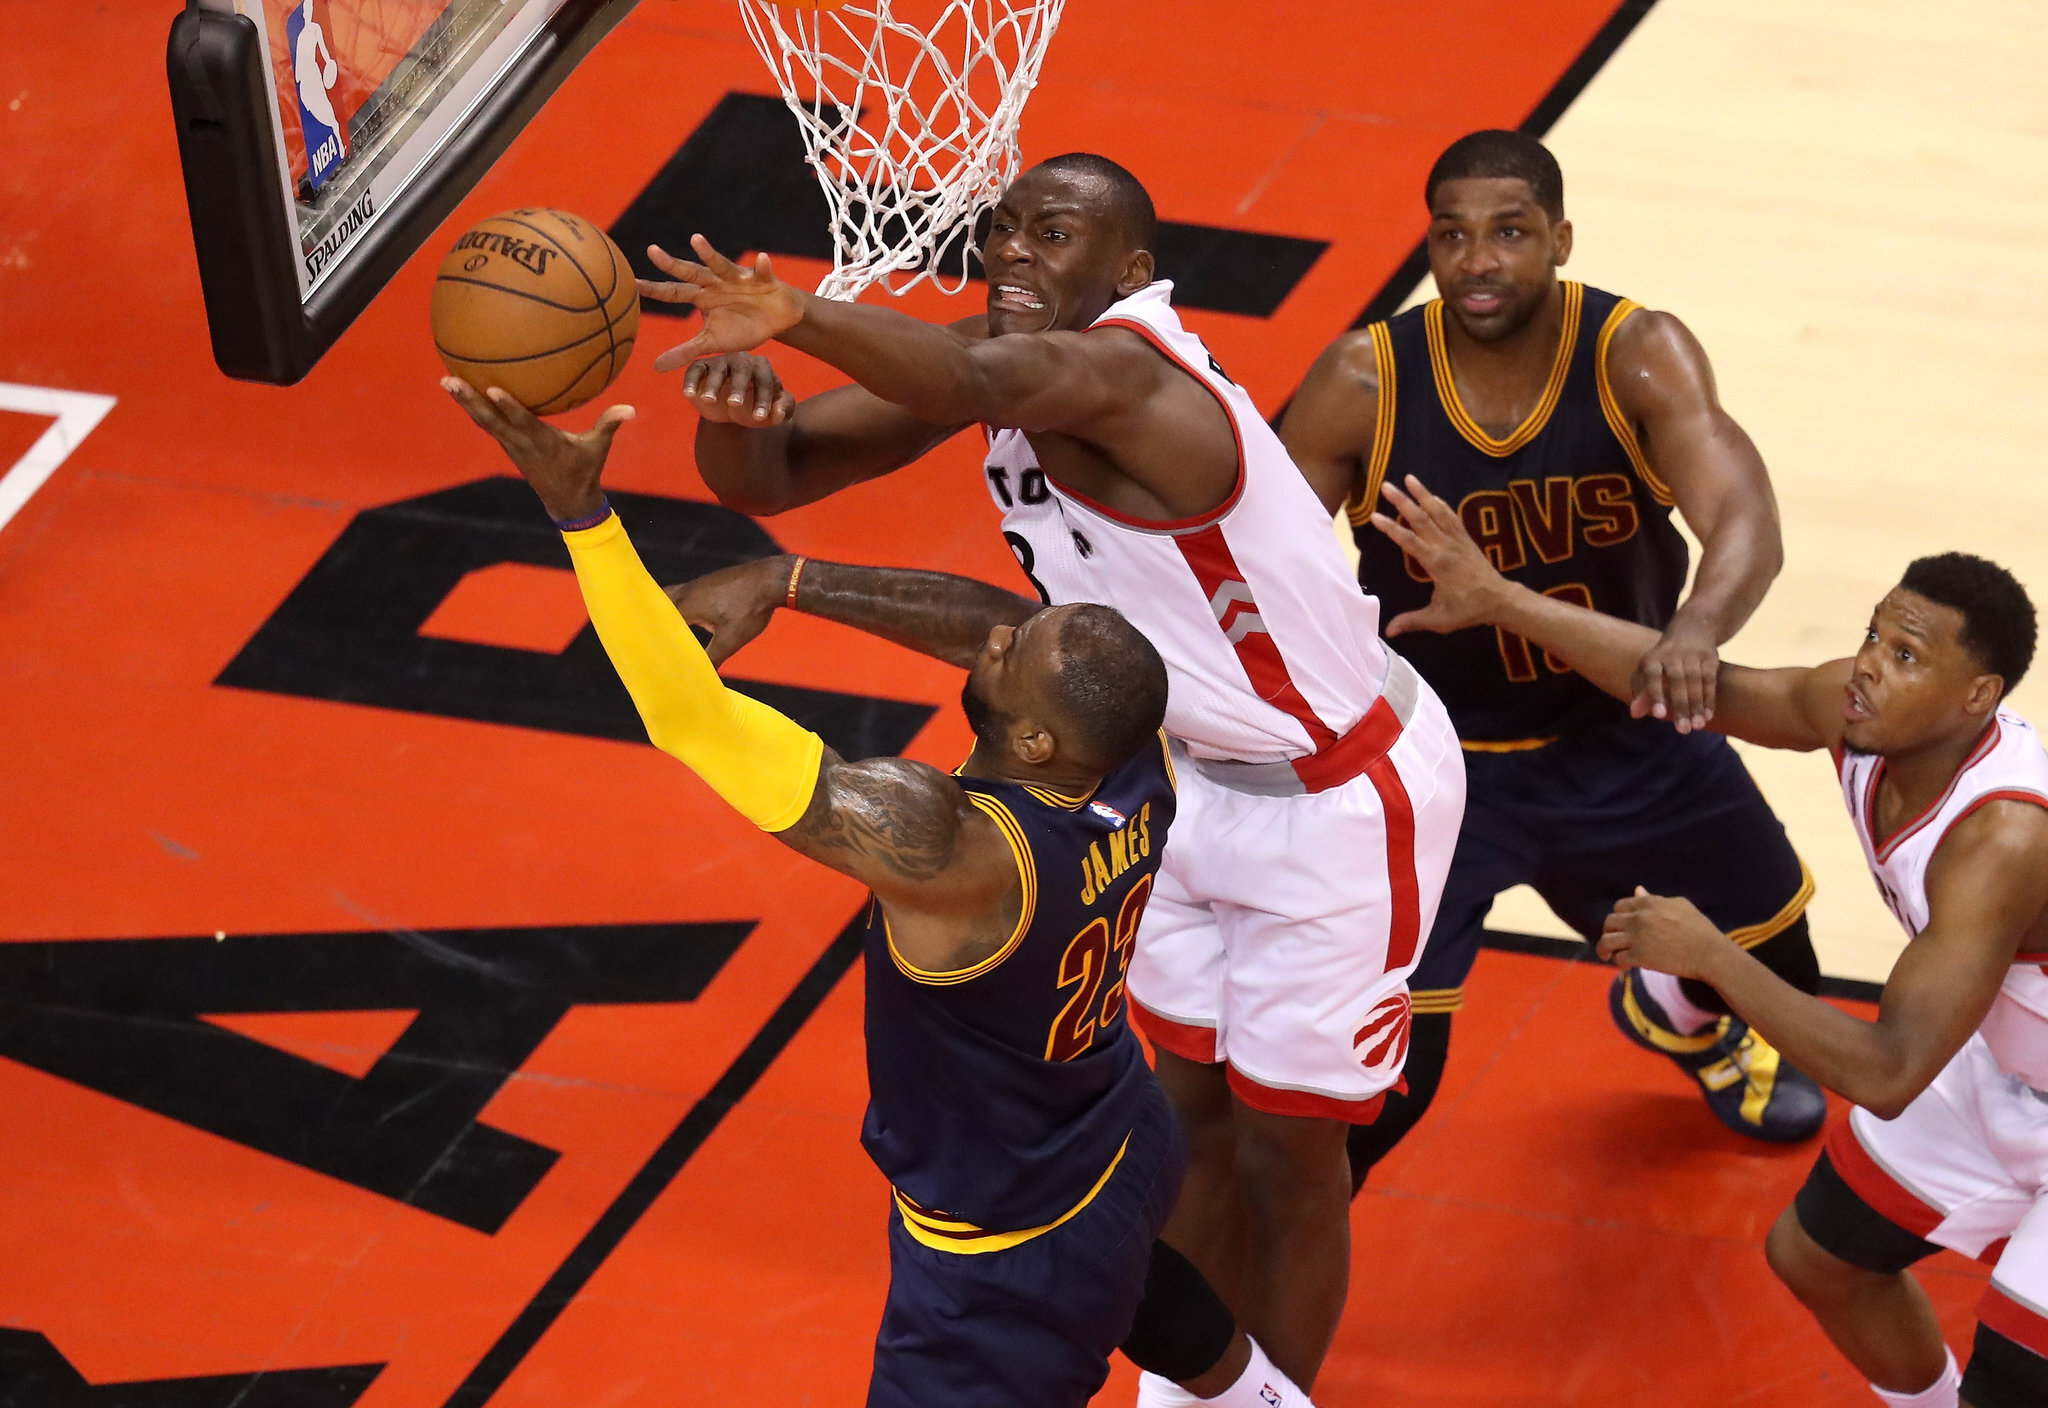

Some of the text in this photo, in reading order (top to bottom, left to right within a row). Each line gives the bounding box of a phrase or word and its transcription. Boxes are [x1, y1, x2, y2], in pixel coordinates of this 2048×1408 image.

[312, 135, 338, 177] NBA
[304, 187, 377, 287] SPALDING
[1080, 801, 1151, 906] JAMES
[1043, 873, 1152, 1063] 23
